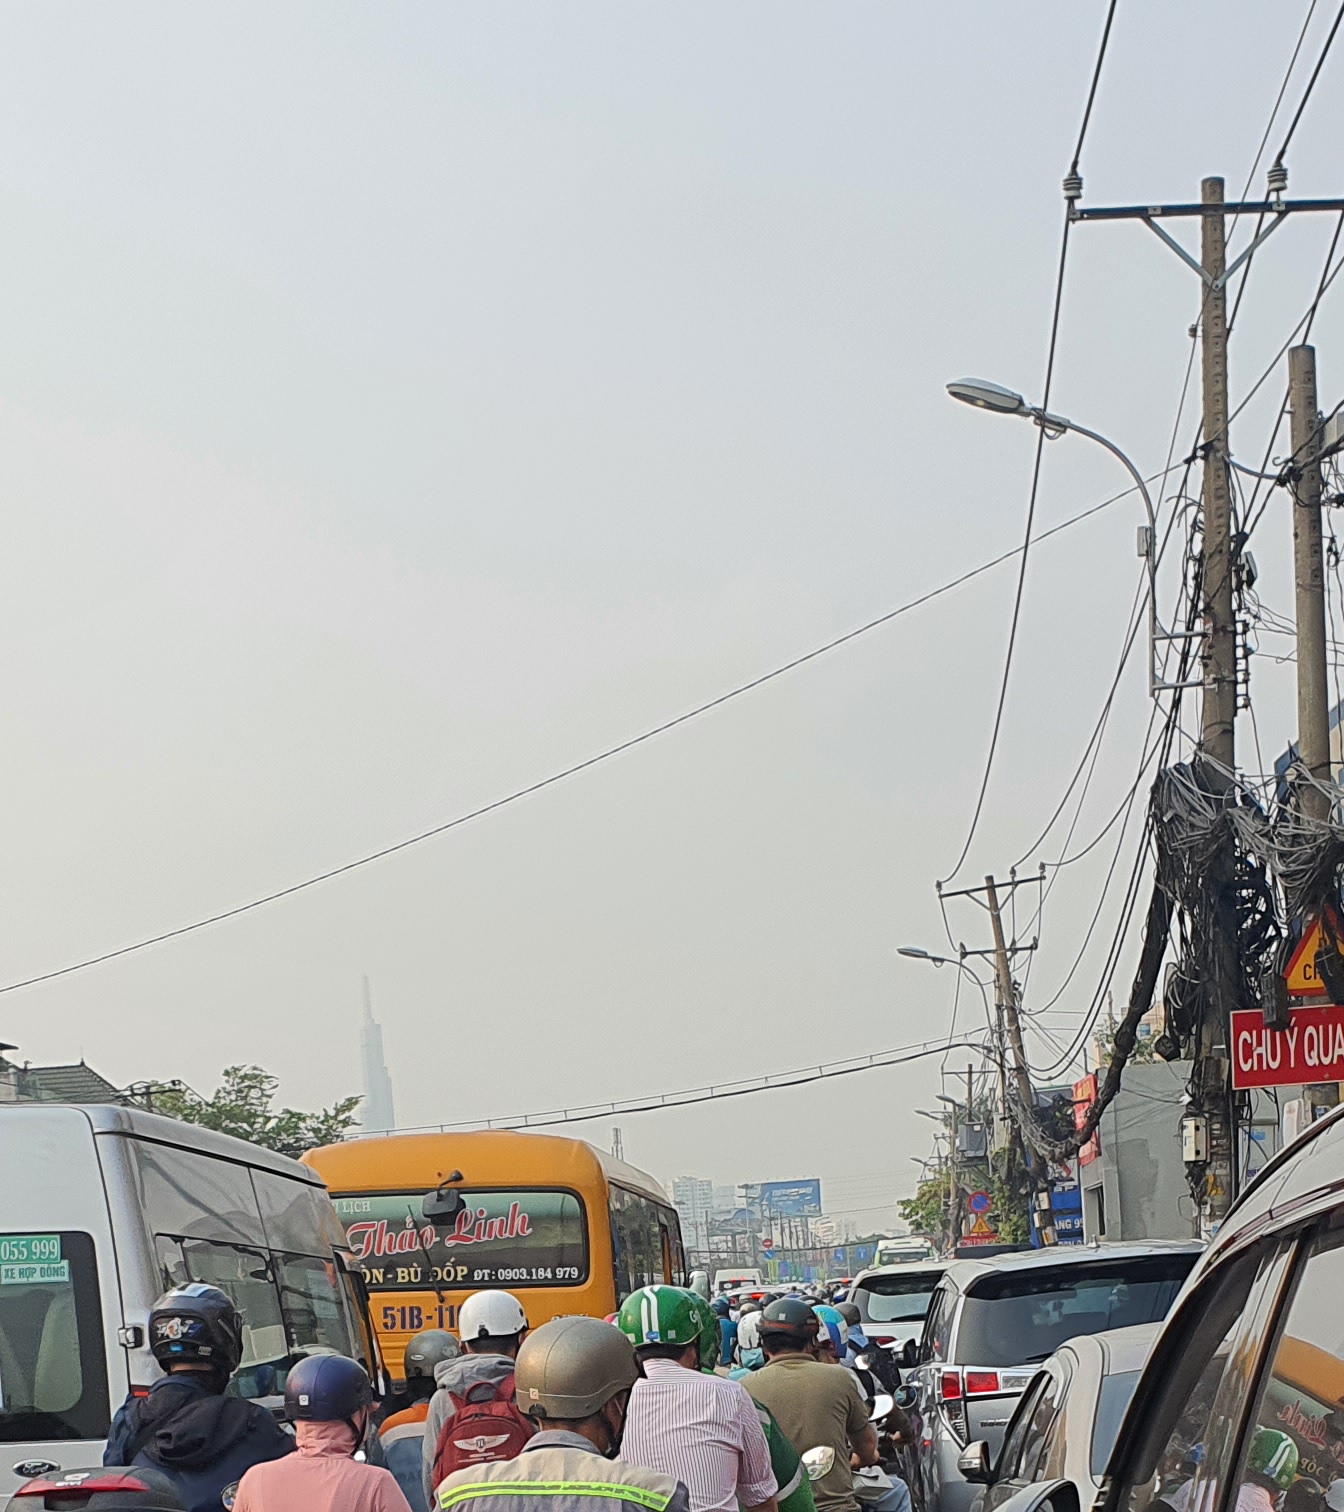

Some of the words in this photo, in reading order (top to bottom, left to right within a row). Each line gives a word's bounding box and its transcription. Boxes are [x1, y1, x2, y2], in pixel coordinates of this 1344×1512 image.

[1287, 1016, 1299, 1069] Ý
[342, 1201, 372, 1214] LỊCH
[445, 1201, 533, 1247] Linh
[0, 1240, 28, 1260] 055
[31, 1239, 58, 1260] 999
[396, 1263, 422, 1283] BÙ
[556, 1266, 578, 1280] 979
[382, 1304, 459, 1331] 51B-11
